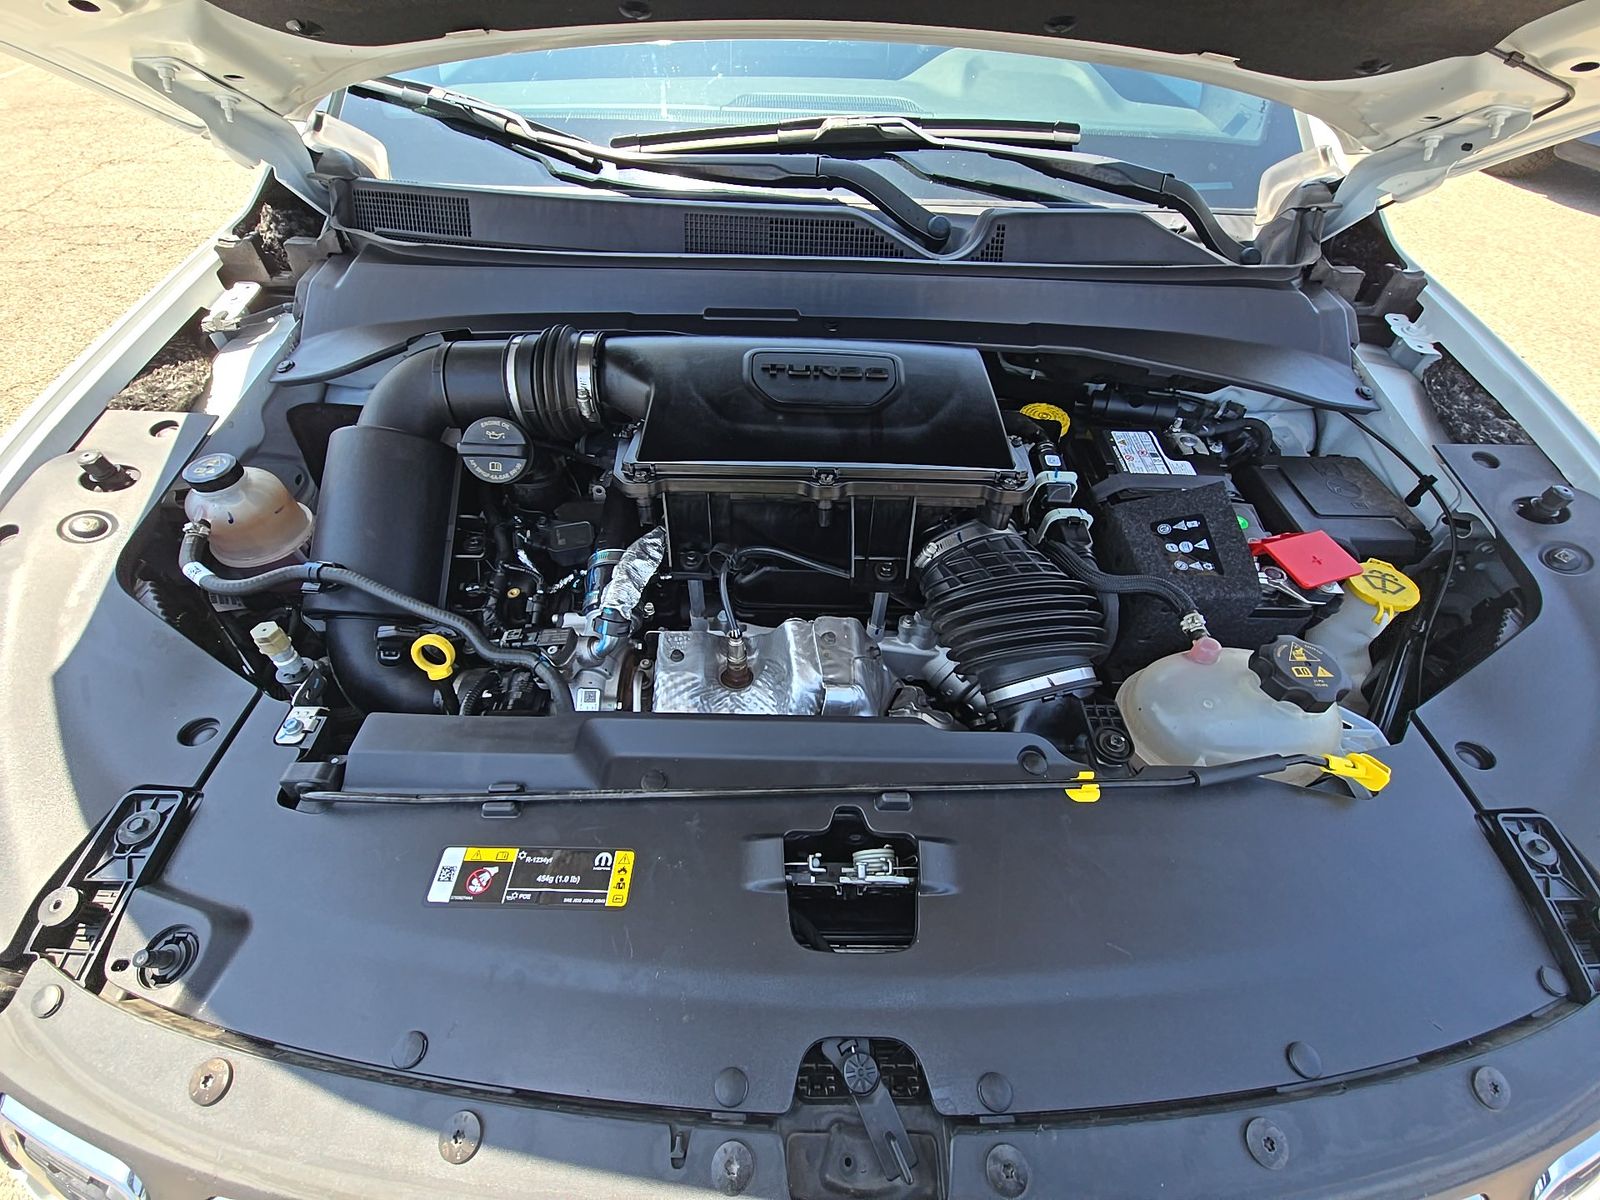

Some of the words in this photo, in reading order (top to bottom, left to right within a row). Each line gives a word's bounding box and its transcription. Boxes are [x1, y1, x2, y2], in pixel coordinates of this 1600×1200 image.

[760, 363, 889, 379] TURBO
[481, 420, 501, 428] ENGINE
[501, 422, 510, 431] OIL
[525, 856, 554, 865] R-1234yf
[536, 874, 554, 884] 454g
[555, 875, 569, 884] (1.0
[570, 875, 581, 885] lb)
